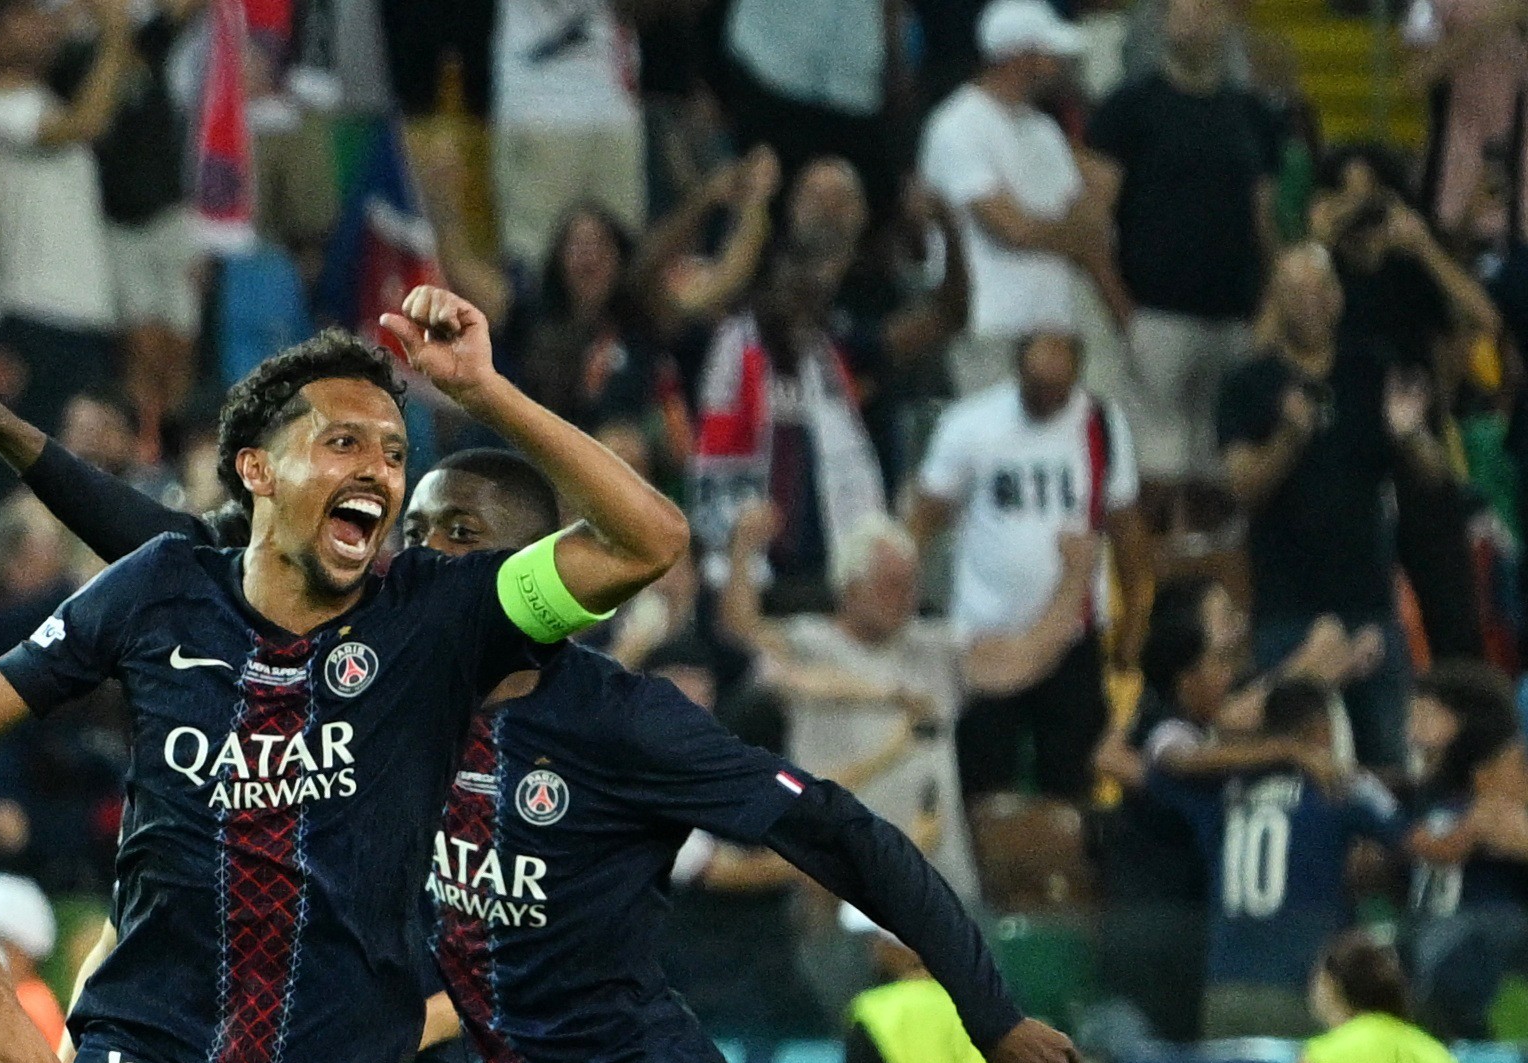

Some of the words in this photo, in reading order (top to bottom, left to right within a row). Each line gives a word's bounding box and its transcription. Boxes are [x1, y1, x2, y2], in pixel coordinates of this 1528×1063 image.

[329, 645, 365, 664] PARIS
[164, 721, 356, 787] QATAR
[208, 768, 357, 809] AIRWAYS
[432, 830, 547, 900] ATAR
[1223, 806, 1290, 919] 10
[425, 871, 547, 928] AIRWAYS
